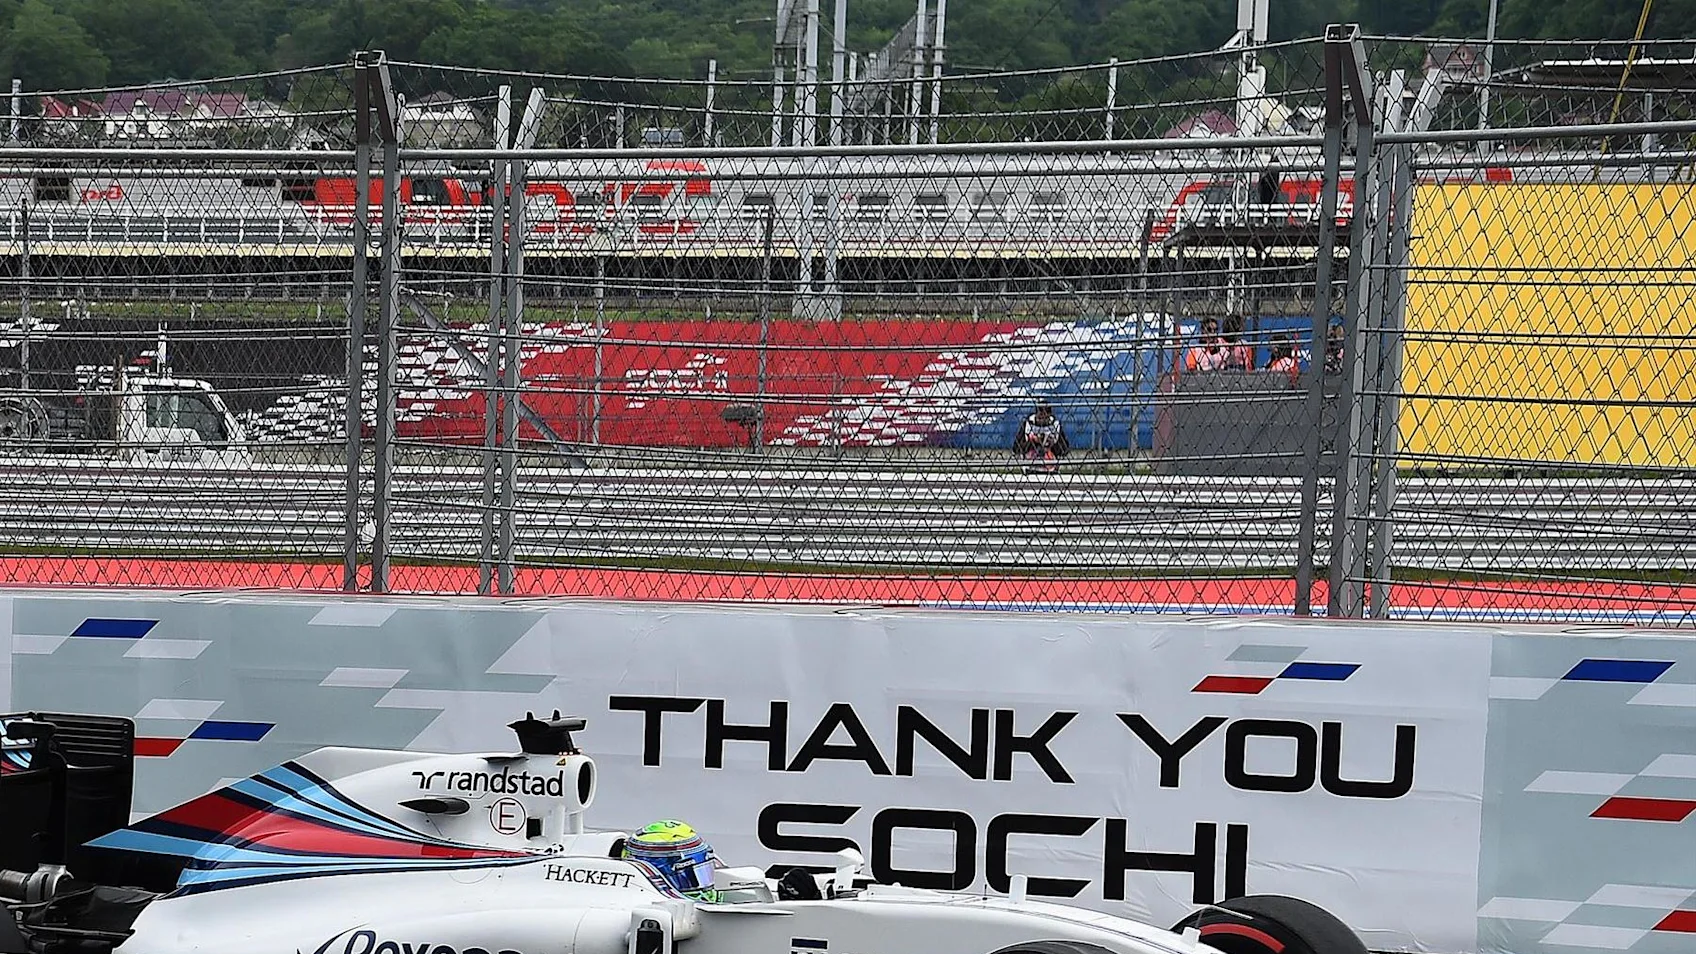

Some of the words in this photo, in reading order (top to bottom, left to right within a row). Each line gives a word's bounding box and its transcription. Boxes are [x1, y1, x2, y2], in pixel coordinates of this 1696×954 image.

[609, 696, 1077, 783] THANK
[1115, 713, 1416, 798] YOU
[446, 766, 564, 797] randstad
[545, 864, 635, 888] HACKETT
[758, 802, 1248, 904] SOCHI
